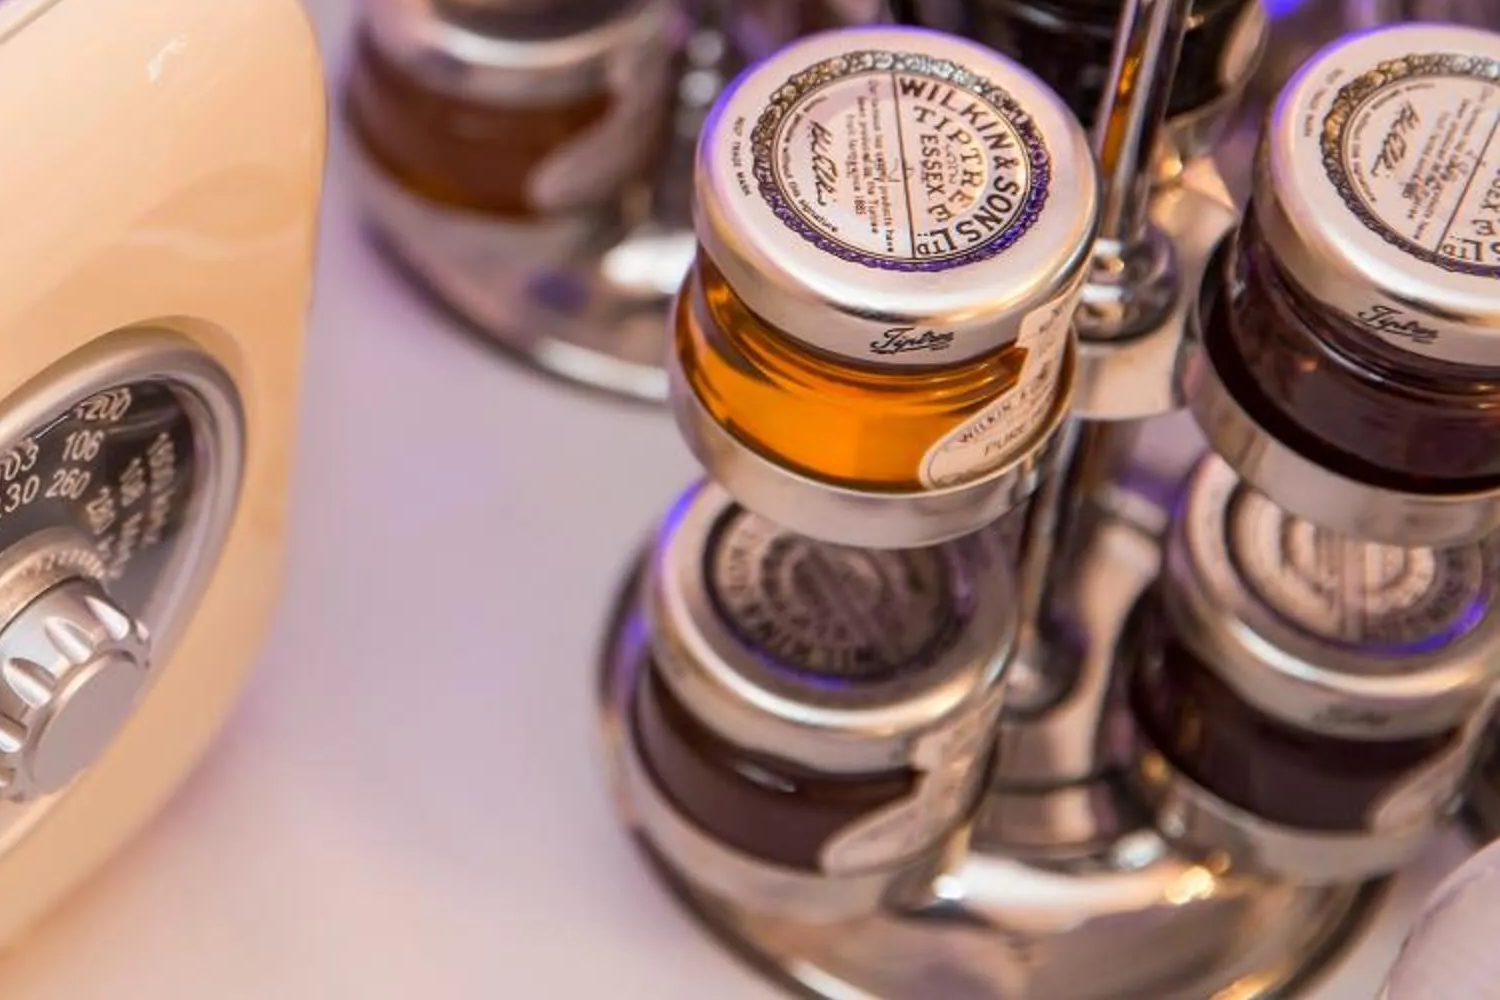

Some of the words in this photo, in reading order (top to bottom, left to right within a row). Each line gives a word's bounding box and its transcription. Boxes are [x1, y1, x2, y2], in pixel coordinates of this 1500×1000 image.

[899, 77, 1014, 150] WILKIN
[913, 105, 986, 222] TIPTREE
[919, 134, 946, 195] ESSEX
[993, 155, 1020, 170] &
[955, 175, 1021, 243] SONS
[62, 429, 104, 462] 106
[46, 468, 91, 500] 260
